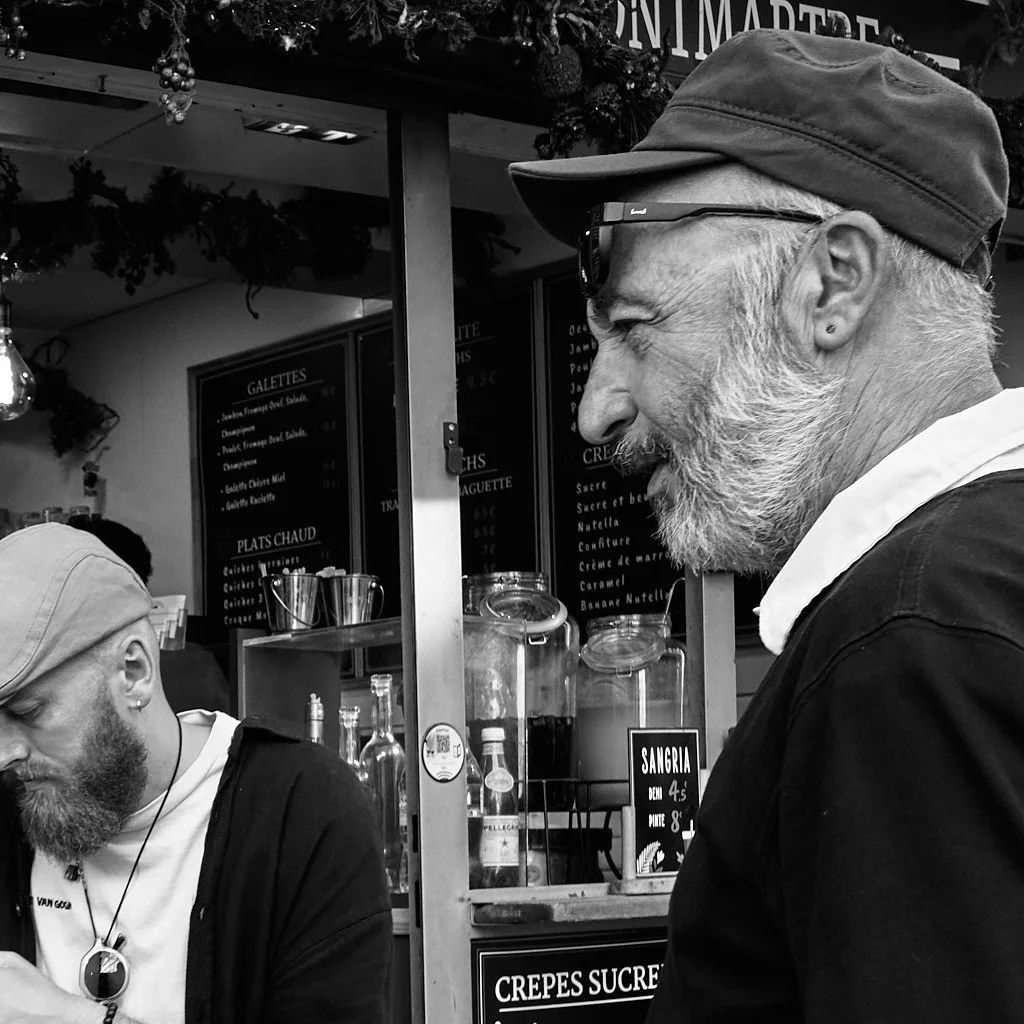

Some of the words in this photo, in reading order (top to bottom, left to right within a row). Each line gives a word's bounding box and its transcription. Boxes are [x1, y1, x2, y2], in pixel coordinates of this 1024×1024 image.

[569, 339, 598, 357] Jamb
[247, 368, 307, 395] GALETTES
[582, 443, 611, 465] CRE
[459, 476, 513, 497] AGUETTE
[578, 516, 619, 533] Nutella
[237, 535, 272, 554] PLATS
[274, 526, 316, 547] CHAUD
[579, 536, 630, 553] Confiture
[635, 550, 672, 564] marro
[580, 574, 625, 592] Caramel
[581, 598, 620, 612] Banane
[642, 747, 690, 774] SANGRIA
[649, 787, 662, 800] DEMI
[649, 814, 665, 827] PINTE
[495, 971, 583, 1002] CREPES
[589, 964, 664, 995] SUCRE
